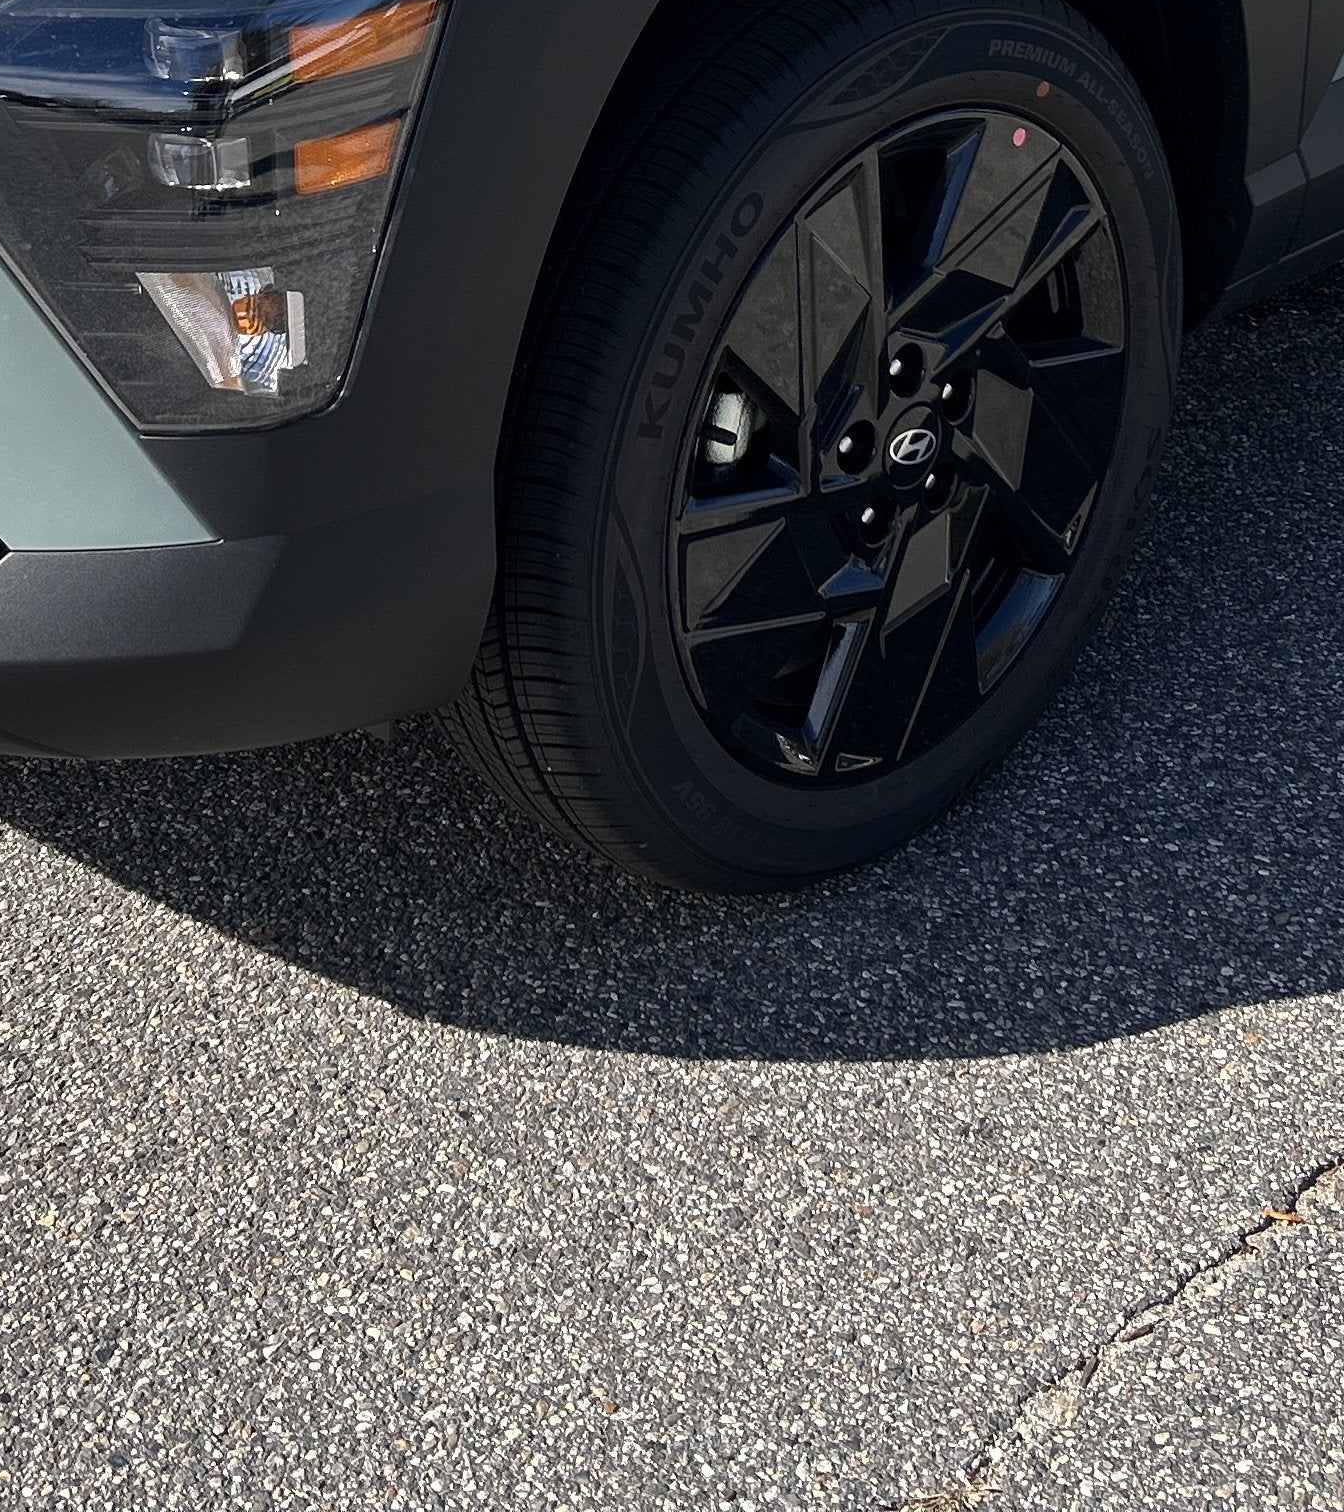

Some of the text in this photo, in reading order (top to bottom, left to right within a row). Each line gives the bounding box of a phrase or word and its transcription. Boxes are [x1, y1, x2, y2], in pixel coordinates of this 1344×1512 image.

[988, 39, 1154, 178] PREMIUM ALL-SEASON
[637, 191, 763, 439] KUMHO
